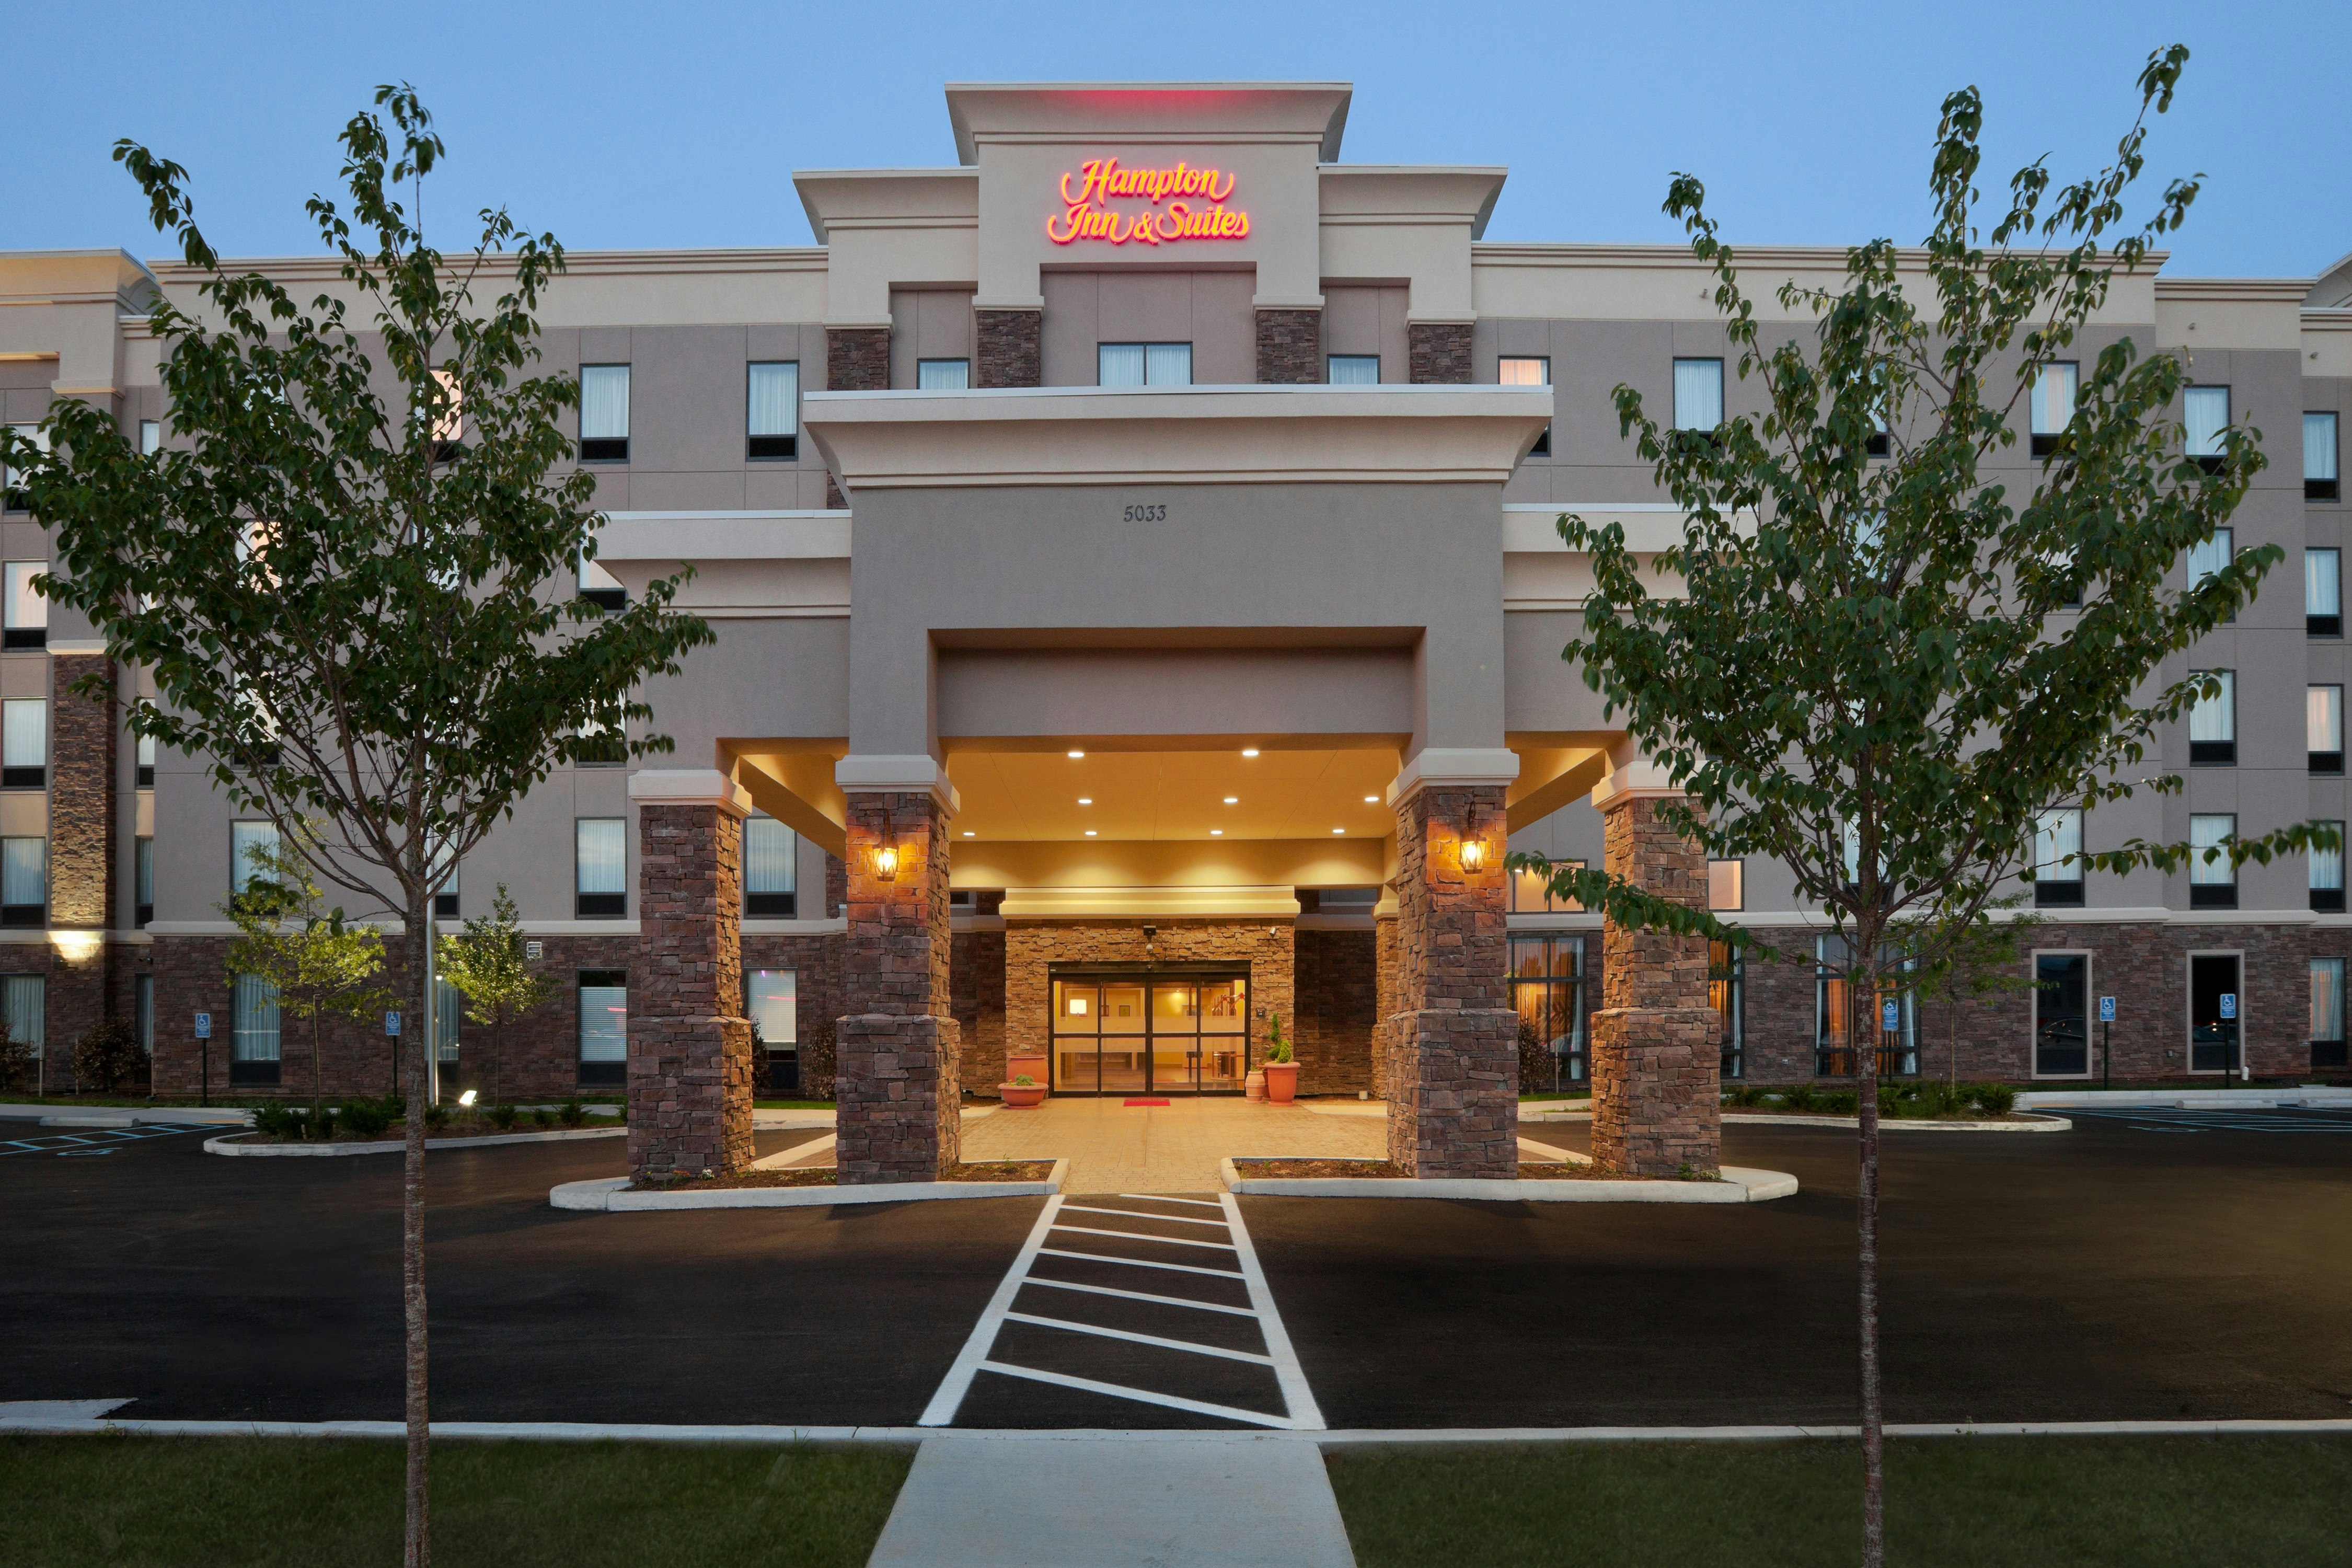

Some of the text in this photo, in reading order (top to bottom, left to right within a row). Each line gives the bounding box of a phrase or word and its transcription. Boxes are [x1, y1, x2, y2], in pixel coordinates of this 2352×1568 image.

[1062, 157, 1233, 207] Hampton
[1047, 202, 1249, 245] Inn & Suites
[1124, 505, 1166, 522] 5033
